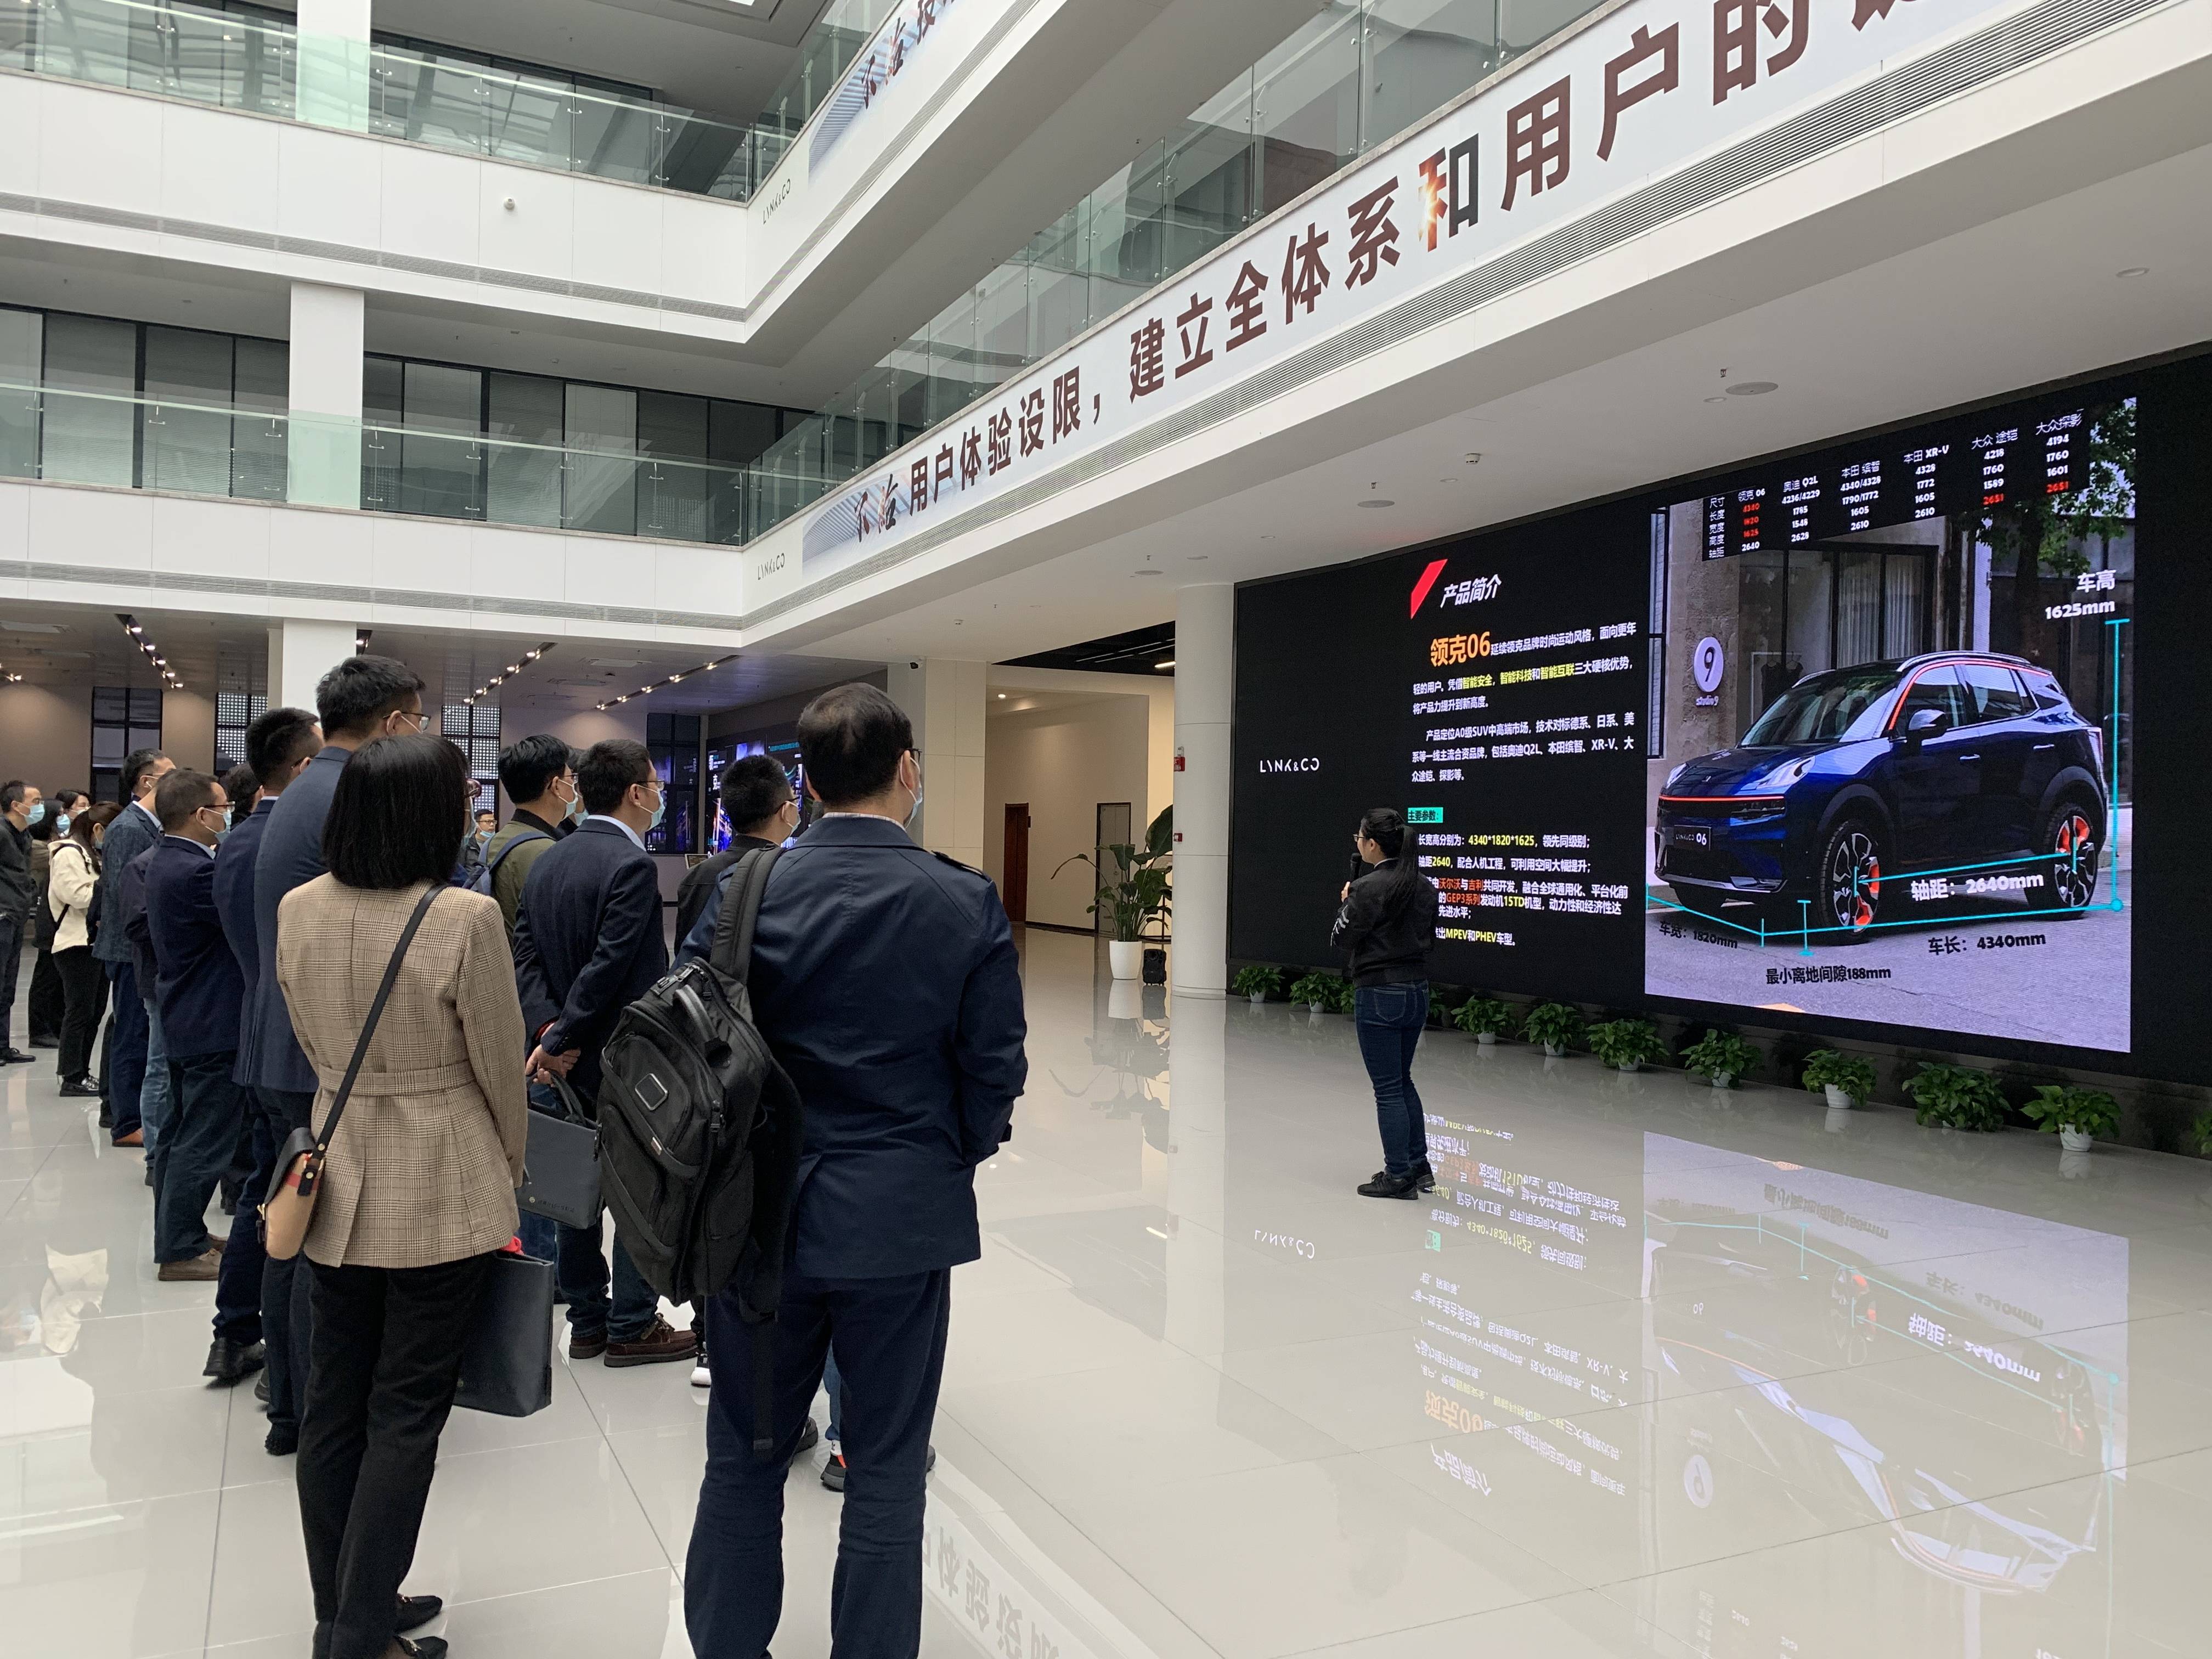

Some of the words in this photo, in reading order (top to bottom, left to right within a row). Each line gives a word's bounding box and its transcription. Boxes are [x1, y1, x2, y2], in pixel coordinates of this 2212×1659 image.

[763, 178, 791, 224] LYNK&CO
[1971, 434, 1994, 450] 大众
[2046, 433, 2069, 447] 4194
[1903, 449, 1923, 464] 本田
[1925, 444, 1949, 459] XR-V
[1984, 448, 2005, 460] 4218
[2046, 449, 2069, 462] 1760
[1841, 465, 1860, 478] 本田
[1915, 463, 1936, 475] 4328
[1983, 464, 2004, 476] 1760
[2047, 465, 2069, 477] 1601
[1802, 475, 1819, 487] Q2L
[1840, 476, 1881, 492] 4340/4328
[1916, 478, 1935, 490] 1772
[1983, 478, 2004, 489] 1589
[1756, 488, 1765, 497] 06
[1781, 489, 1820, 505] 4236/4229
[1841, 490, 1879, 505] 1790/1772
[1915, 492, 1935, 504] 1605
[1709, 496, 1725, 509] 尺寸
[1709, 509, 1725, 522] 长度
[1792, 505, 1808, 516] 1785
[1850, 506, 1870, 517] 1605
[1915, 506, 1935, 518] 2610
[1709, 522, 1725, 534] 宽度
[1792, 518, 1808, 528] 1548
[1850, 520, 1870, 531] 2610
[1709, 534, 1725, 546] 高度
[1791, 532, 1809, 543] 2628
[1741, 541, 1760, 552] 2640
[758, 552, 785, 580] LYNK&CO
[2076, 569, 2117, 593] 车高
[1440, 574, 1502, 608] 产品简介
[2045, 601, 2115, 619] 1625mm
[1260, 758, 1319, 772] LYNK&CO
[1696, 833, 1707, 845] 06
[1765, 965, 1892, 985] 最小离地间隙188mm
